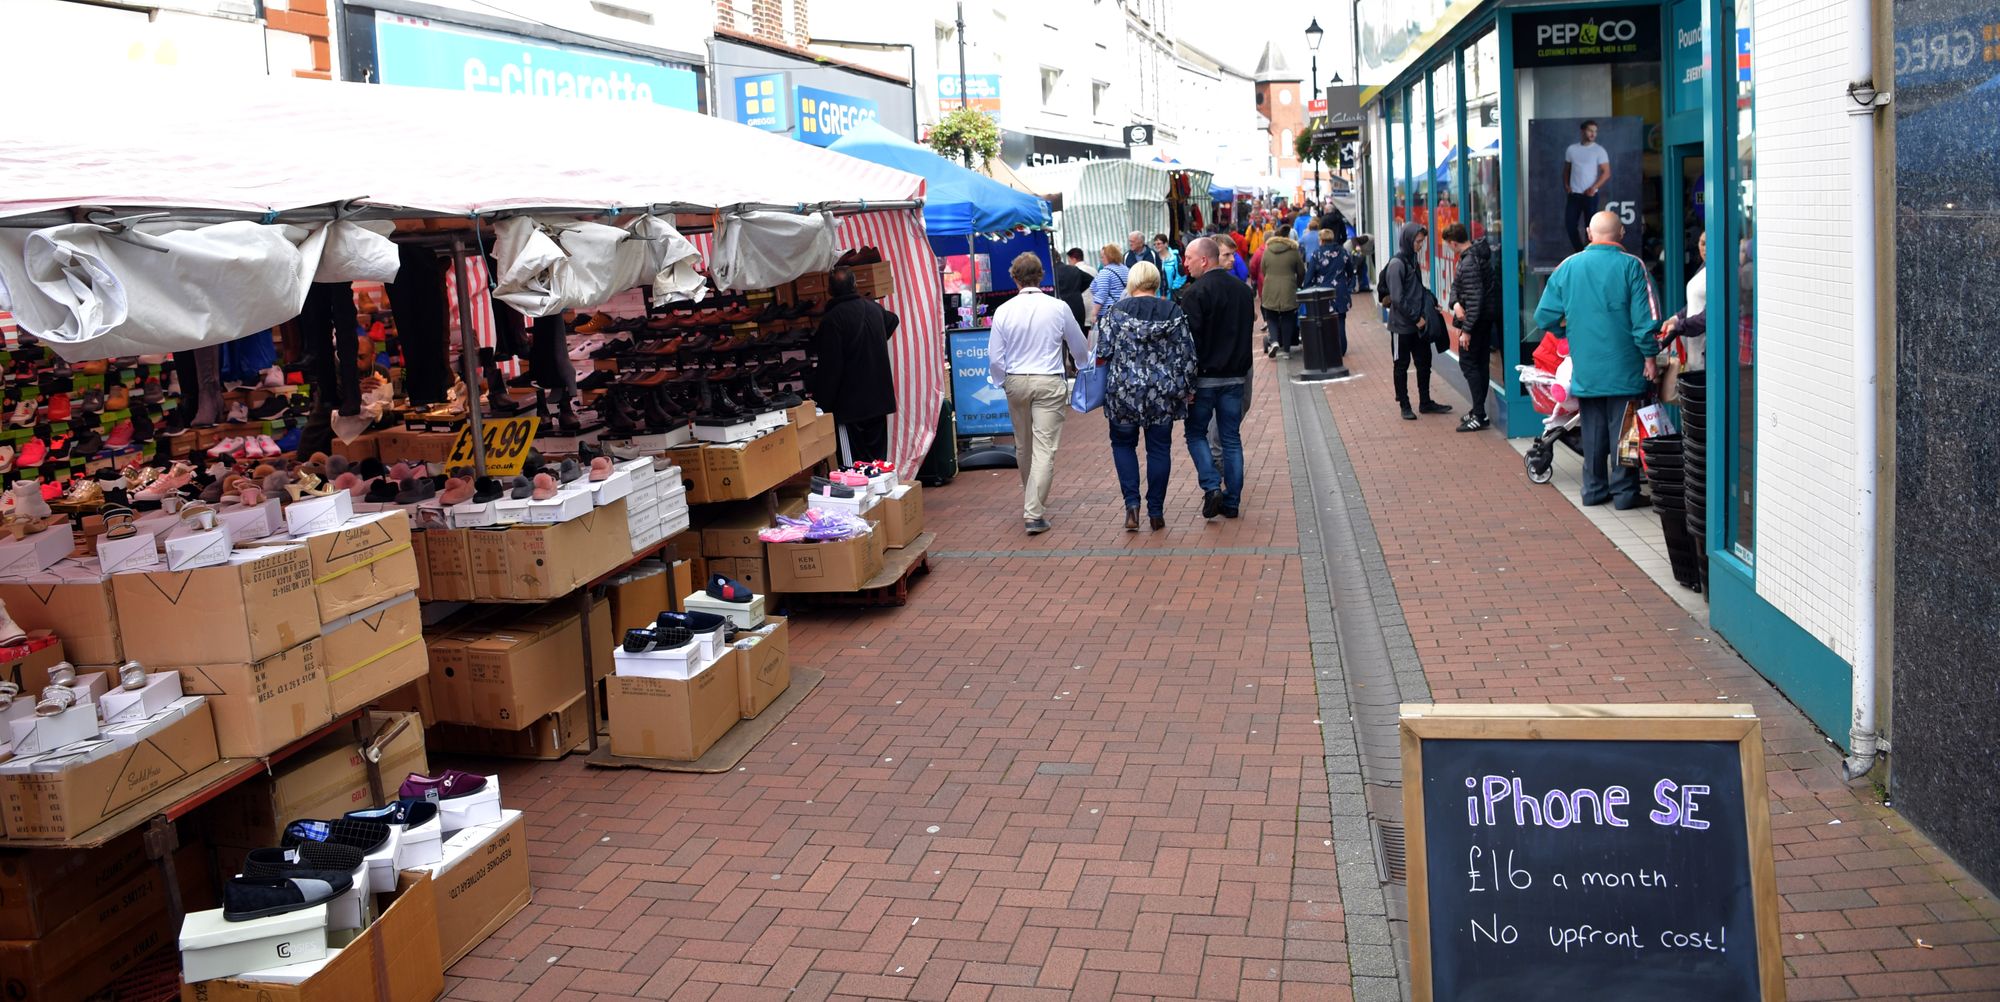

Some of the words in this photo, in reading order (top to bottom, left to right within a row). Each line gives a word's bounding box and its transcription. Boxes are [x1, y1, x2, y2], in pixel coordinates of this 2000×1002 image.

[1566, 47, 1578, 55] FOR
[1603, 45, 1616, 53] MEN
[1623, 44, 1637, 52] KIDS
[1314, 100, 1325, 108] Let
[747, 117, 776, 126] GREGGS
[1331, 112, 1366, 123] Clarks
[959, 368, 985, 377] NOW
[1465, 775, 1630, 829] iPhone
[1649, 778, 1711, 830] SE
[487, 847, 512, 873] RESPONSE
[1467, 845, 1532, 893] £16
[1552, 872, 1569, 890] a
[1581, 868, 1679, 889] month.
[460, 866, 486, 892] FOOTWEAR
[1470, 912, 1518, 944] No
[1549, 925, 1644, 953] upfront
[1660, 926, 1727, 952] cost!
